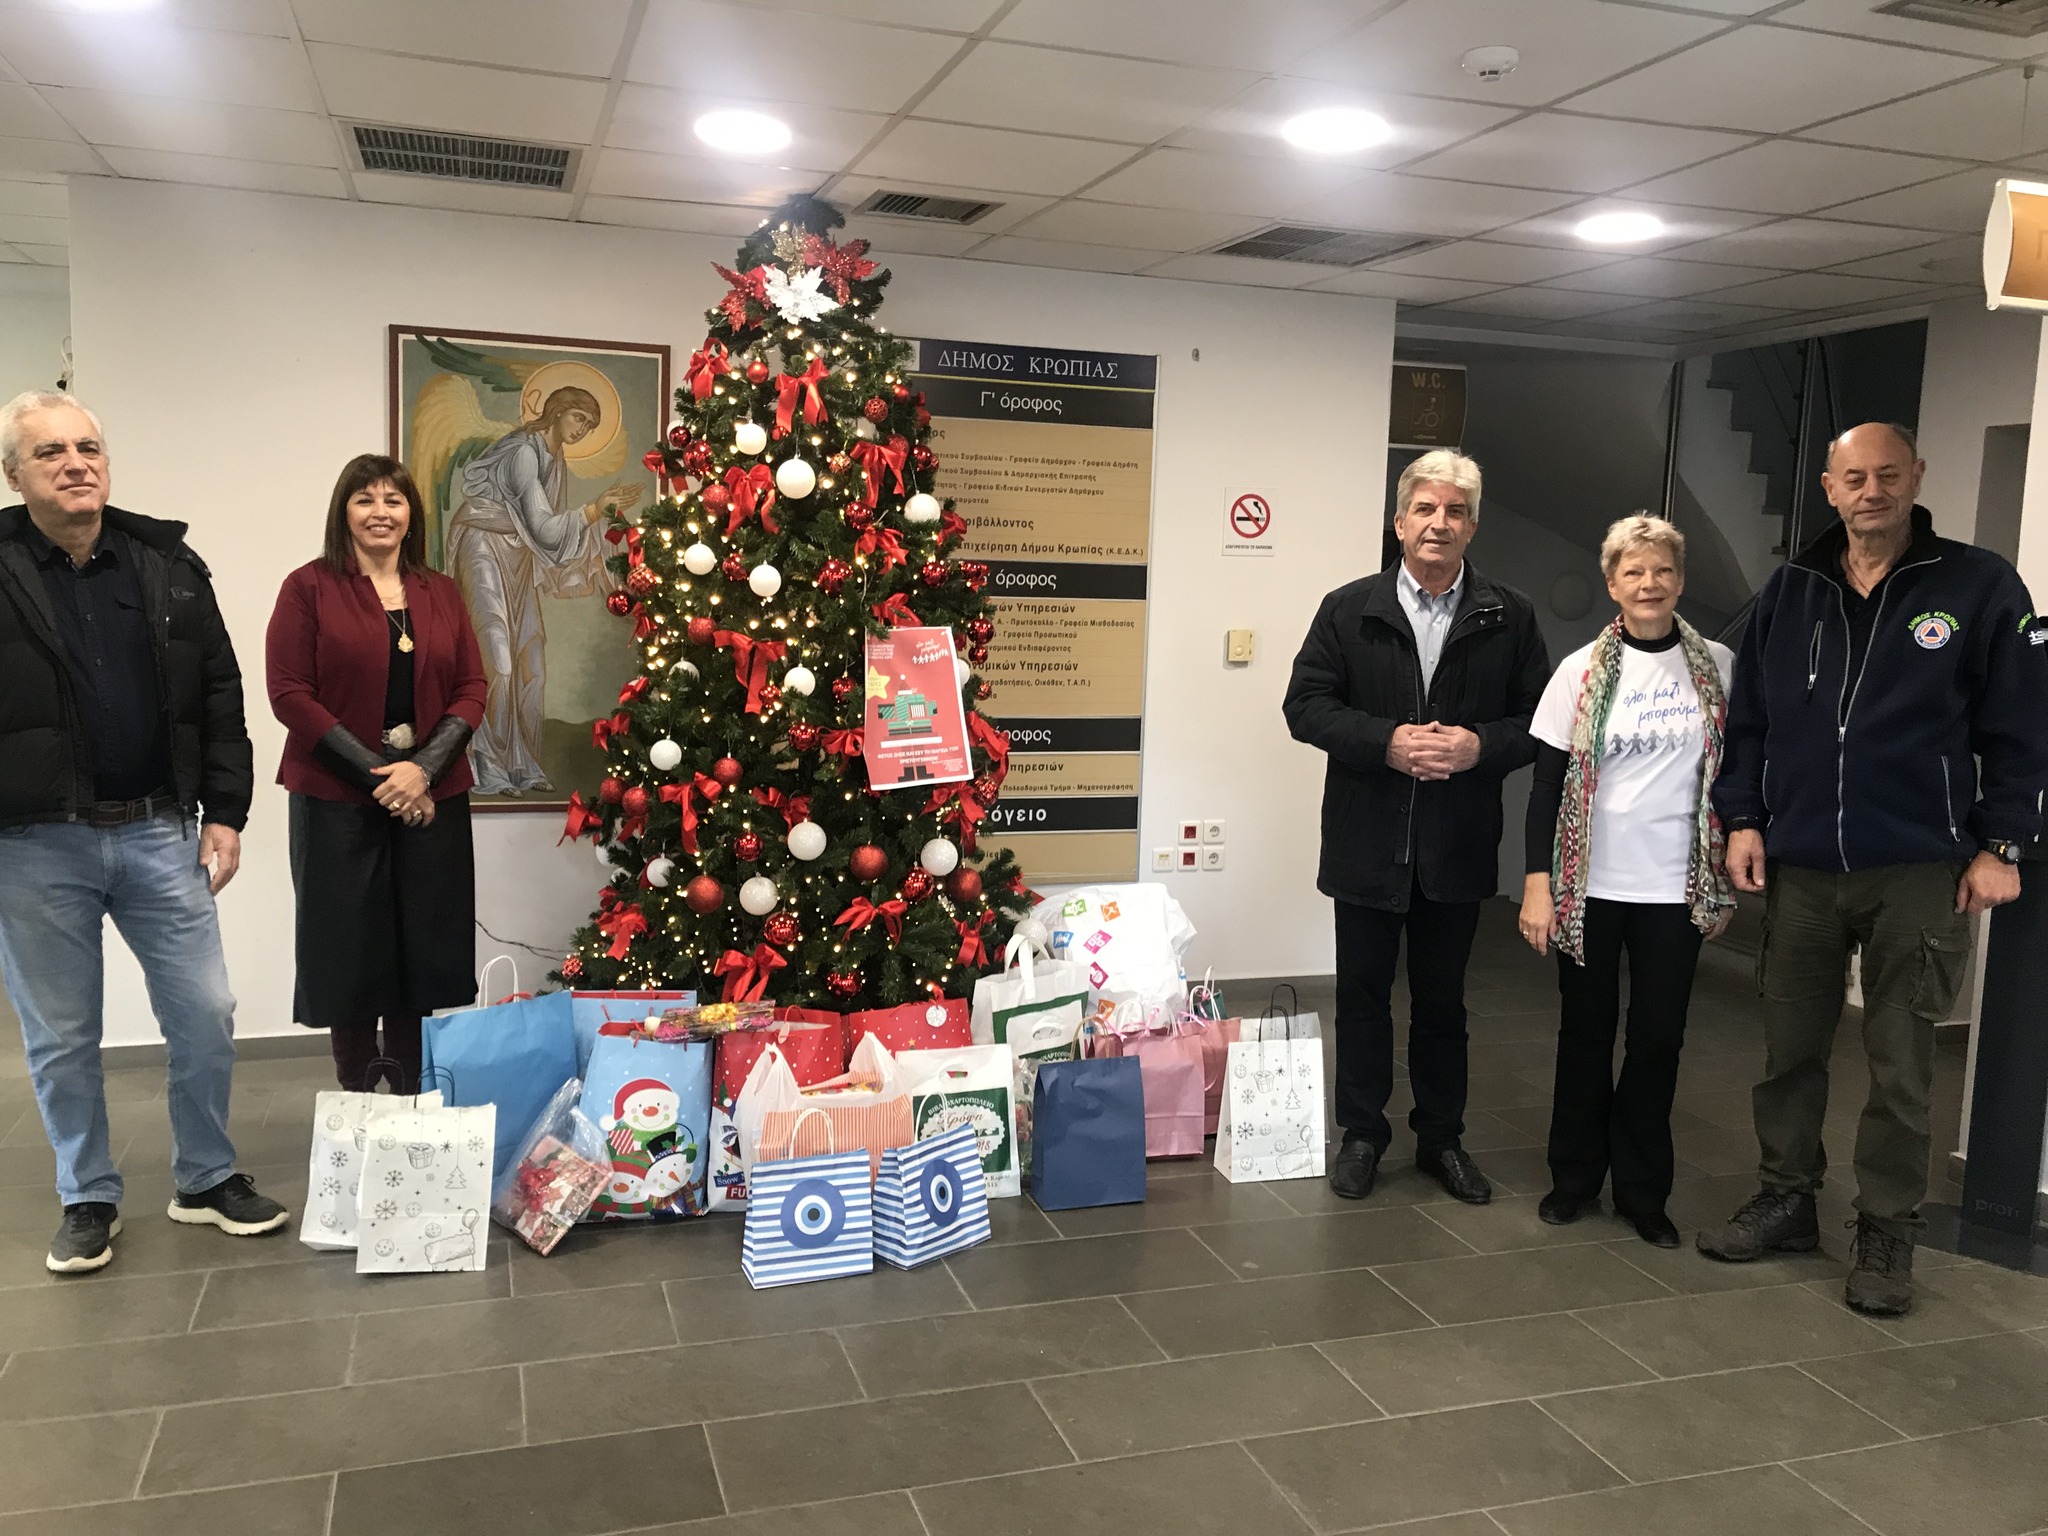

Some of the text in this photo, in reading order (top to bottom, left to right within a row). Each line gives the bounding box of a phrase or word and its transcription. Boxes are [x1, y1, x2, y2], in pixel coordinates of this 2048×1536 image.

[938, 350, 1118, 379] ΔΗΜΟΣ ΚΡΩΠΙΑΣ
[1412, 372, 1446, 388] W.C.
[1000, 392, 1063, 415] όροφος
[1082, 459, 1111, 467] Γραφείο
[964, 483, 993, 491] Γραφείο
[1021, 543, 1054, 554] Δήμου
[1058, 544, 1103, 555] Κρωπίας
[995, 569, 1057, 590] όροφος
[1017, 603, 1076, 614] Υπηρεσιών
[1010, 619, 1054, 627] Πρωτόκολλο
[1908, 611, 1960, 632] ΔΗΜΟΣ ΚΡΩΠΙΑΣ
[1034, 631, 1077, 639] Προσωπικού
[1020, 660, 1078, 673] Υπηρεσιών
[1623, 681, 1680, 708] όλοι μαζί
